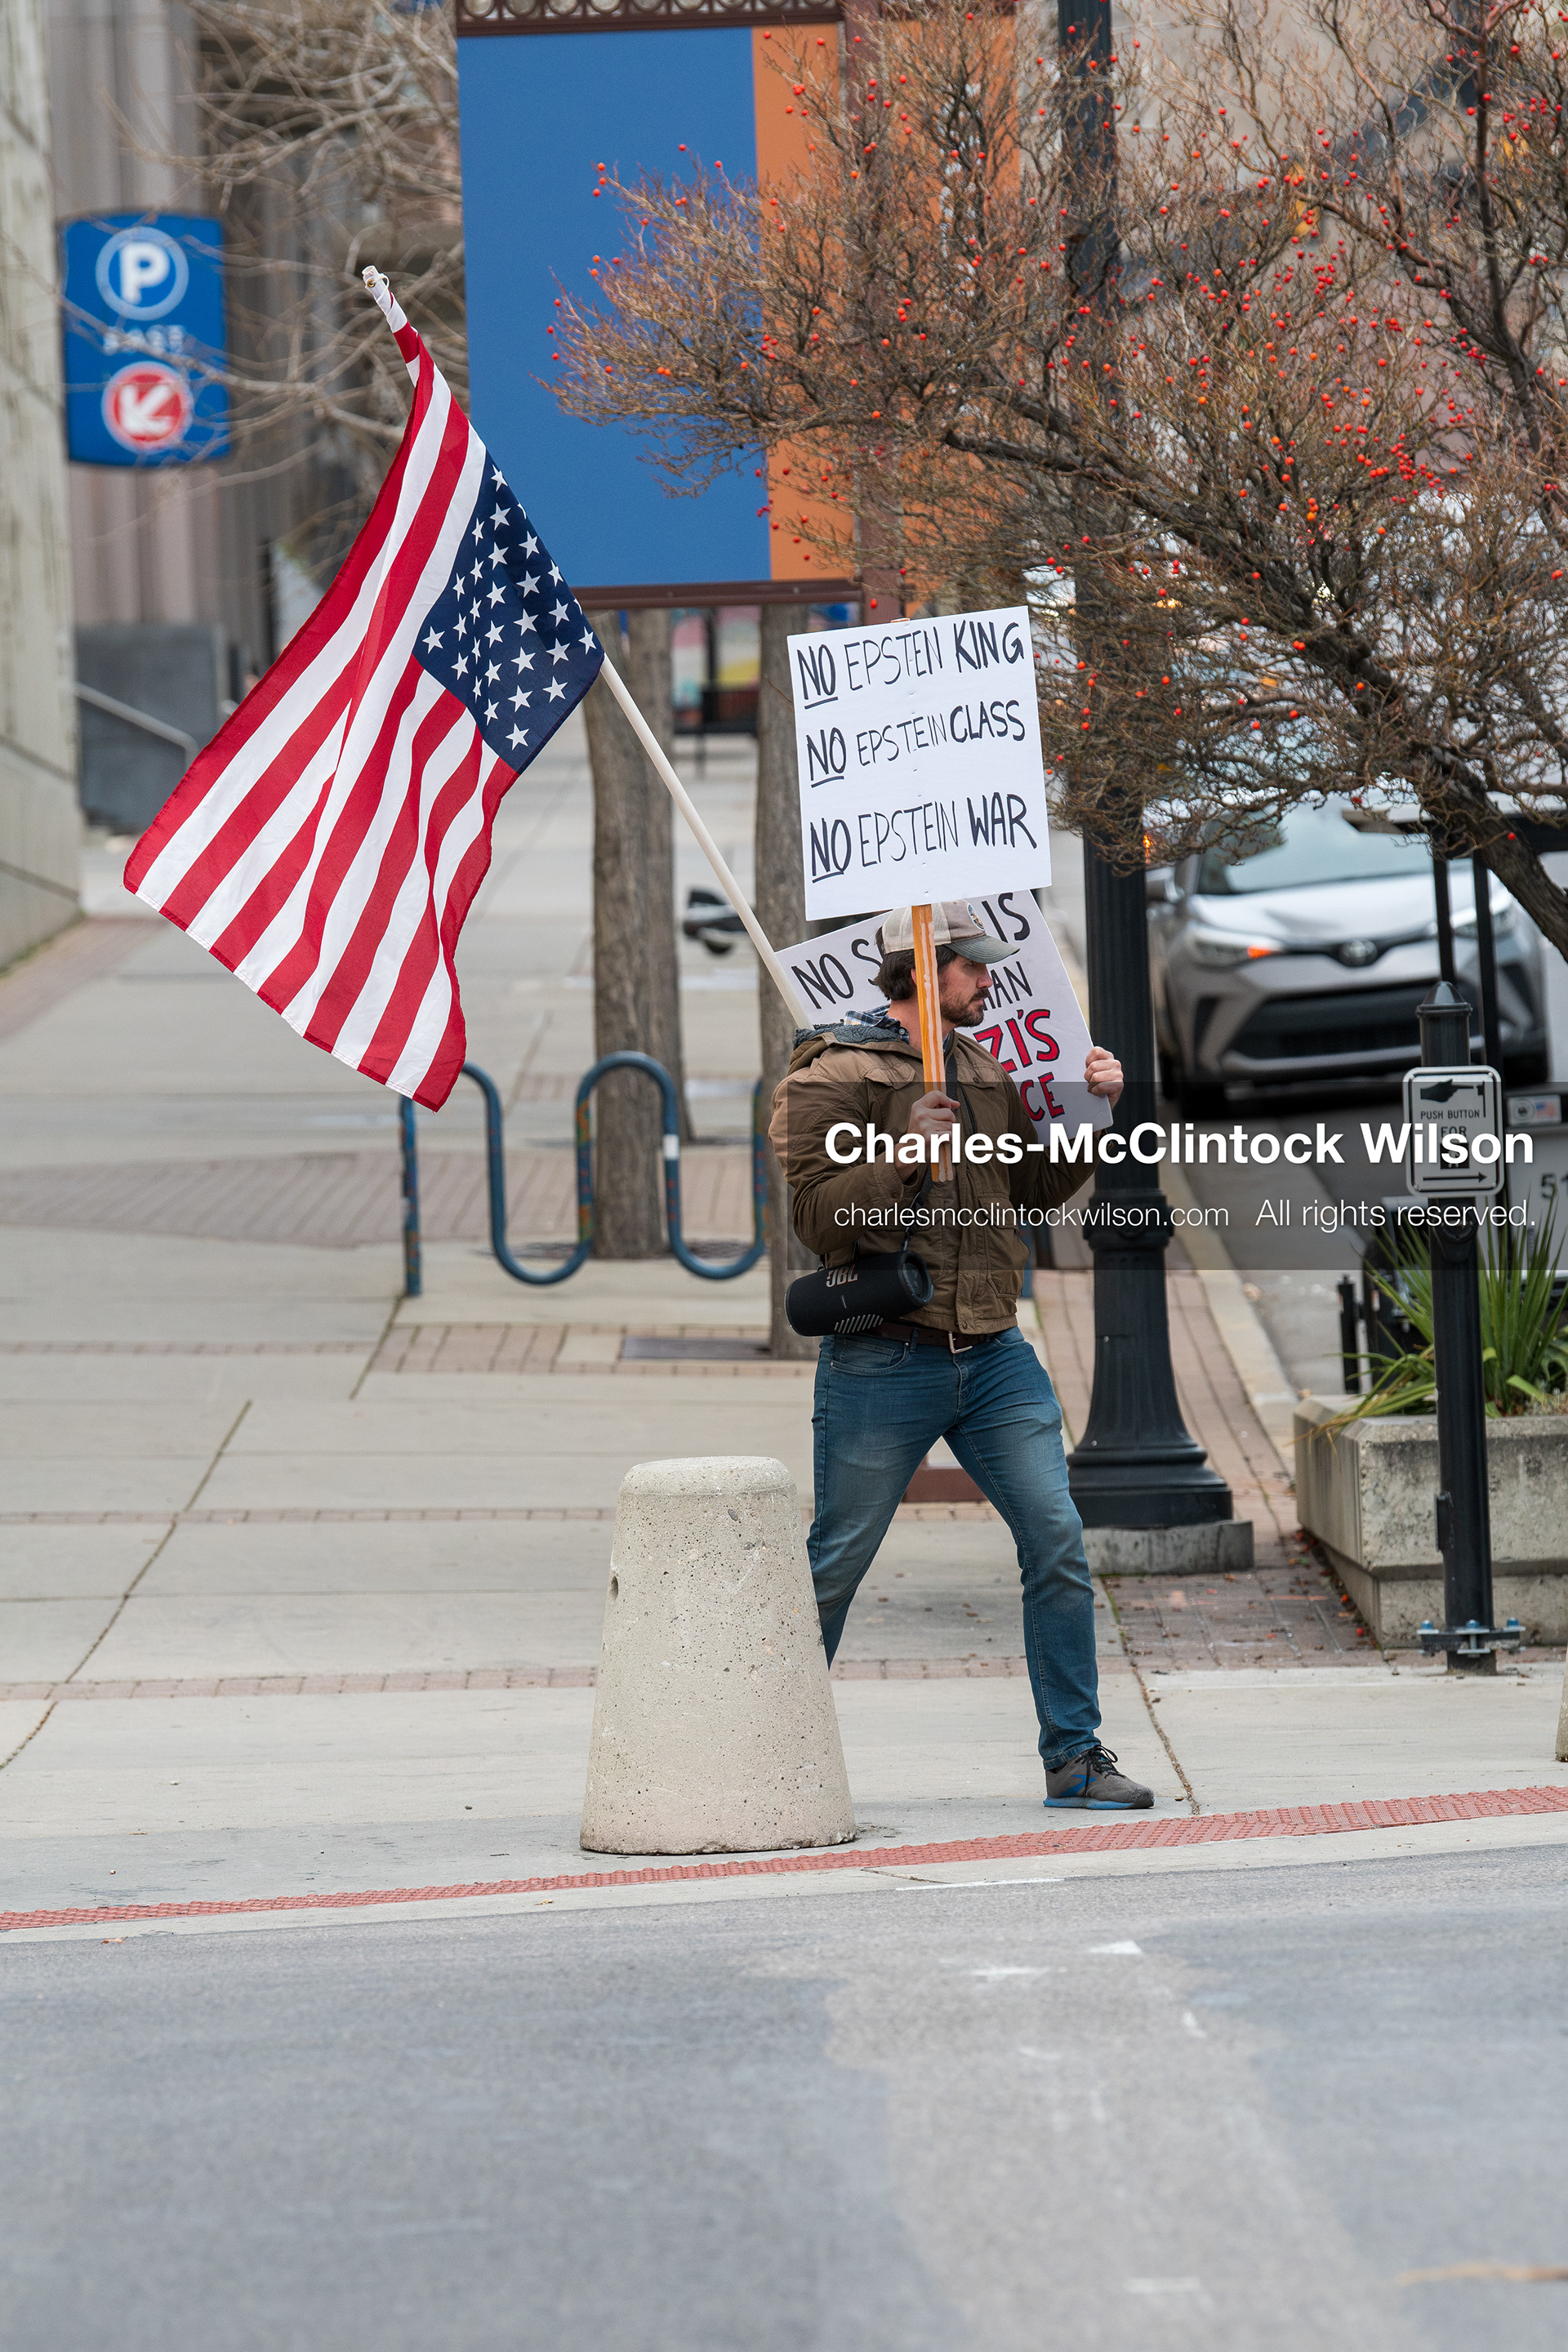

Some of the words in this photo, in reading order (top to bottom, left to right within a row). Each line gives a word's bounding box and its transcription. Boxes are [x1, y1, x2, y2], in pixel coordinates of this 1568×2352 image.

[121, 239, 170, 305] P
[796, 644, 837, 701] NO
[954, 620, 1025, 673] KING
[805, 727, 847, 782] NO
[856, 712, 947, 766] EPSTEIN
[950, 700, 1026, 743] CLASS
[809, 817, 852, 877] NO
[858, 800, 959, 867] EPSTEIN
[966, 791, 1038, 849] WAR
[791, 953, 854, 1009] NO
[974, 1008, 1061, 1072] ZI'S
[1020, 1071, 1066, 1123] CE
[1420, 1109, 1444, 1120] PUSH
[1447, 1108, 1480, 1119] BUTTON
[1441, 1125, 1468, 1139] FOR
[826, 1263, 858, 1288] JBL
